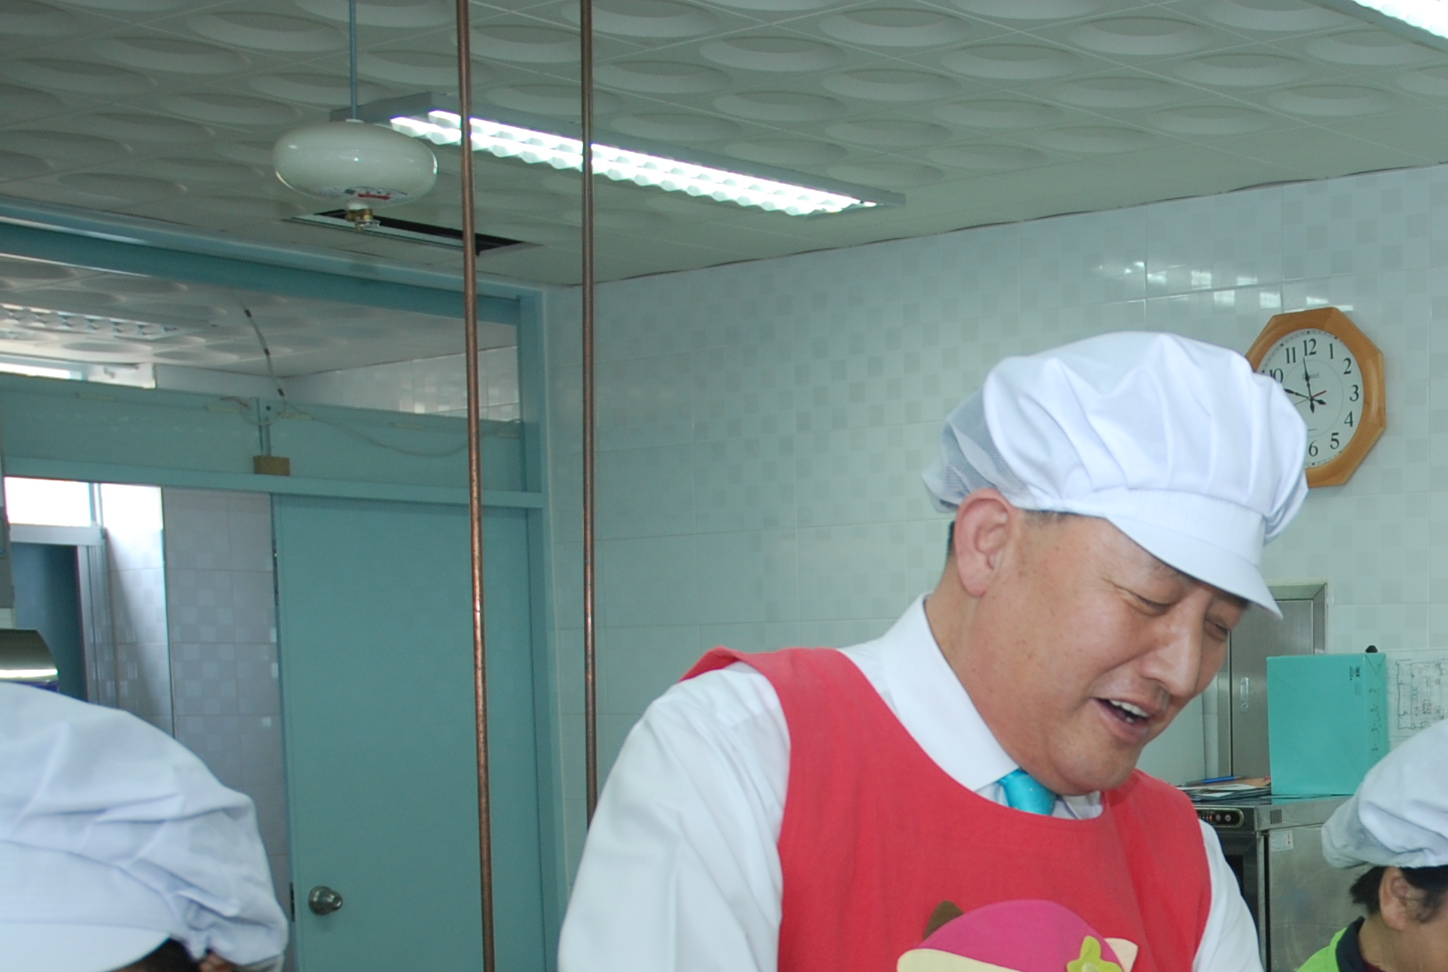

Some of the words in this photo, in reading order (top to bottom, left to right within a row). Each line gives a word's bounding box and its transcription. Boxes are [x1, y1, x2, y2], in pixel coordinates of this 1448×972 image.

[1286, 346, 1296, 364] 11
[1303, 338, 1317, 356] 12
[1329, 343, 1334, 359] 1
[1343, 357, 1352, 375] 2
[1349, 384, 1360, 402] 3
[1344, 411, 1354, 427] 4
[1308, 440, 1319, 457] 6
[1330, 432, 1340, 450] 5
